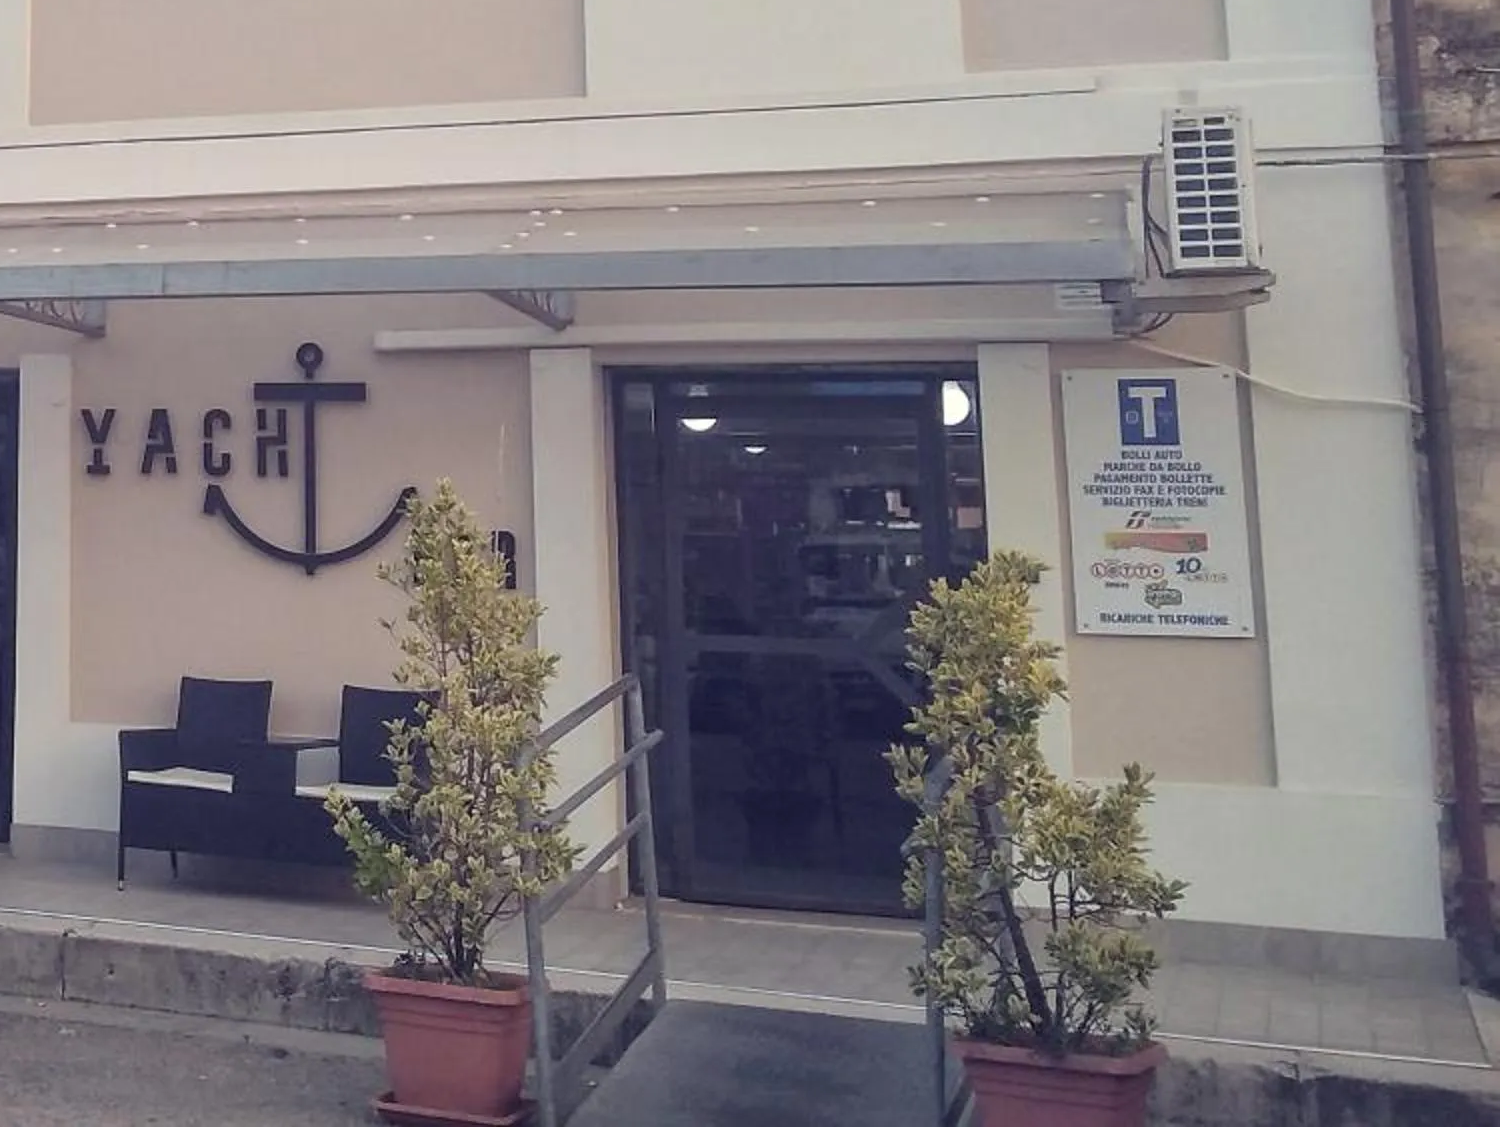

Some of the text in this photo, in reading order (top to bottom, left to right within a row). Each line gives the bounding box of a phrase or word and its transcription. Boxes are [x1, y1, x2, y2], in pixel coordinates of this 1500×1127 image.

[1128, 386, 1167, 438] T
[1121, 450, 1183, 460] BOLLI AUTO
[1103, 462, 1202, 472] MARCHE DA BOLLO
[1093, 473, 1214, 484] PAGAMENTO BOLLETTE
[1083, 485, 1227, 496] SERVIZIO FAX E FOTOCOPIE
[1102, 496, 1209, 507] BIGLIETTERIA TRENI
[1176, 557, 1202, 574] 10
[1100, 613, 1229, 625] RICARICHE TELEFONICHE
